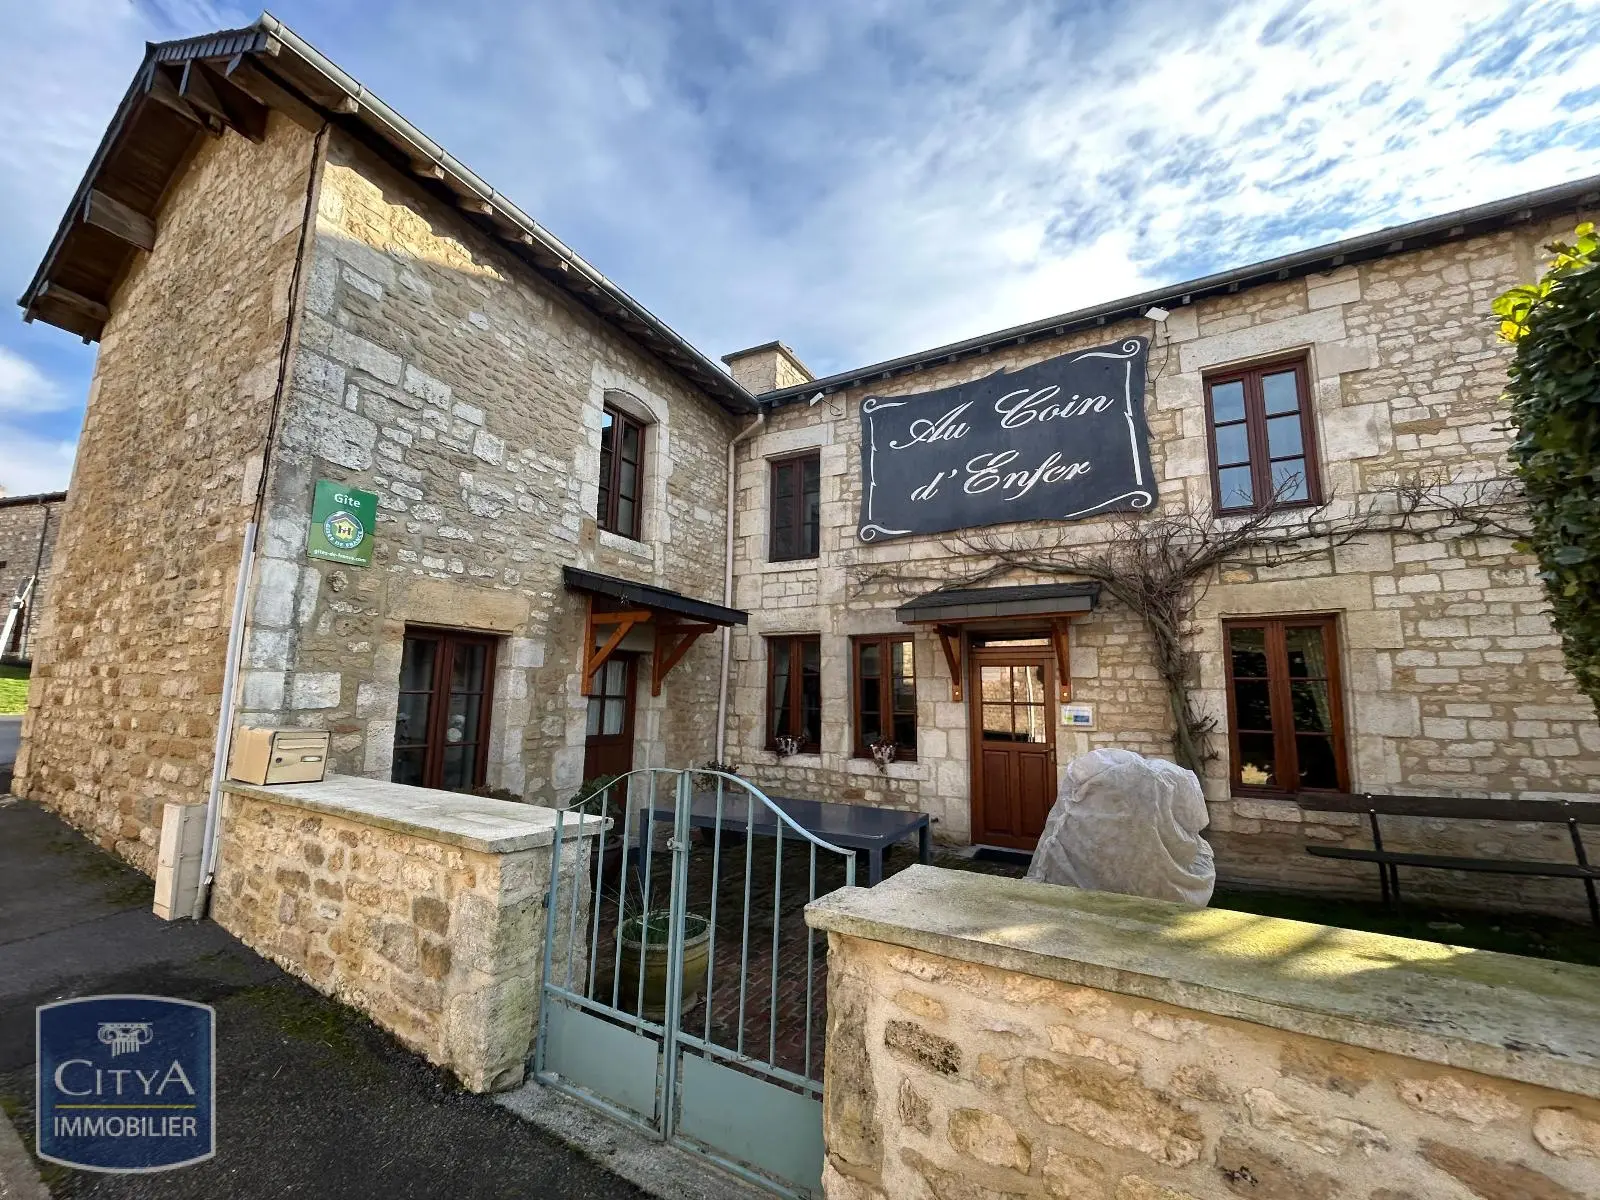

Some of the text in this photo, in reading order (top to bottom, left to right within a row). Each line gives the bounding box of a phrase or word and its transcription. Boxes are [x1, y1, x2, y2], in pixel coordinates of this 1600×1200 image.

[889, 385, 1114, 449] Au Coin
[334, 493, 360, 507] Gîte
